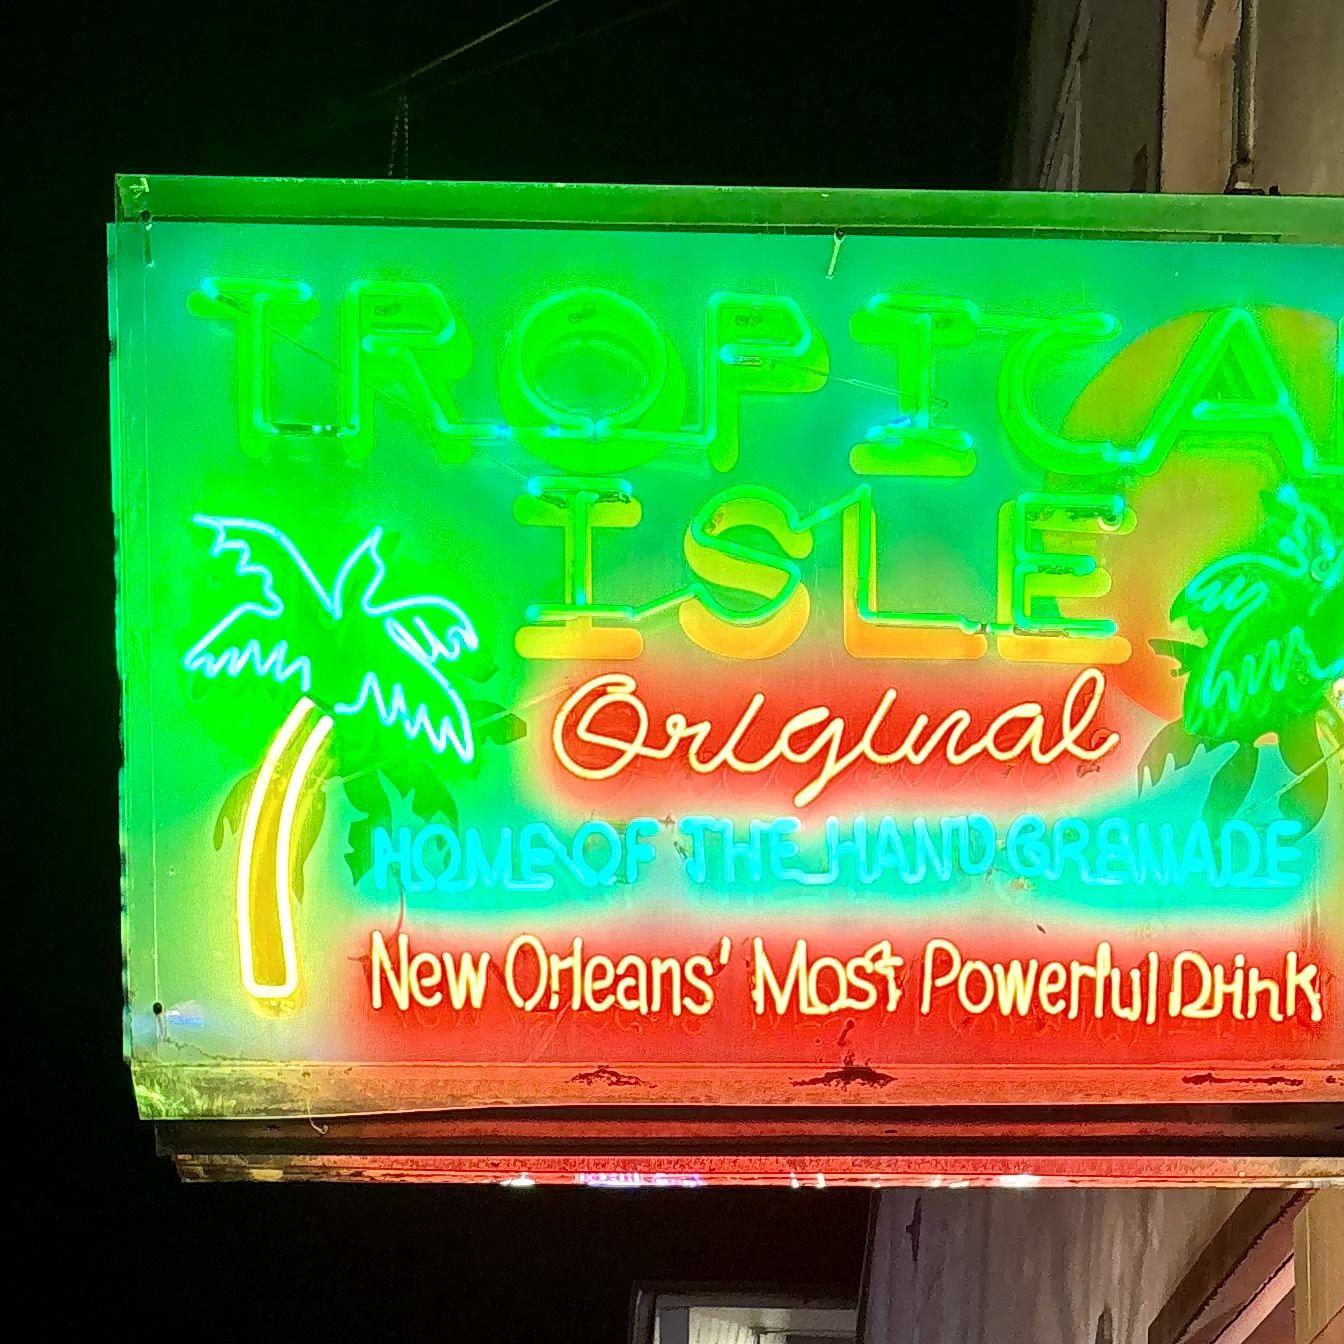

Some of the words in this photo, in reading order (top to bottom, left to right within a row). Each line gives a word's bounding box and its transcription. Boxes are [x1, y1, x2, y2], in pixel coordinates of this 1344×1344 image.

[514, 475, 1137, 662] ISLE
[552, 667, 1120, 805] Original
[372, 822, 554, 892] HOME
[570, 818, 660, 886] OF
[678, 815, 802, 885] THE
[824, 812, 997, 885] HAND
[1006, 812, 1303, 889] GRENADE
[370, 928, 491, 1012] New
[504, 932, 733, 1017] Orleans'
[752, 935, 904, 1016] Most
[920, 937, 1159, 1026] Powerful
[1168, 950, 1323, 1023] Drink
